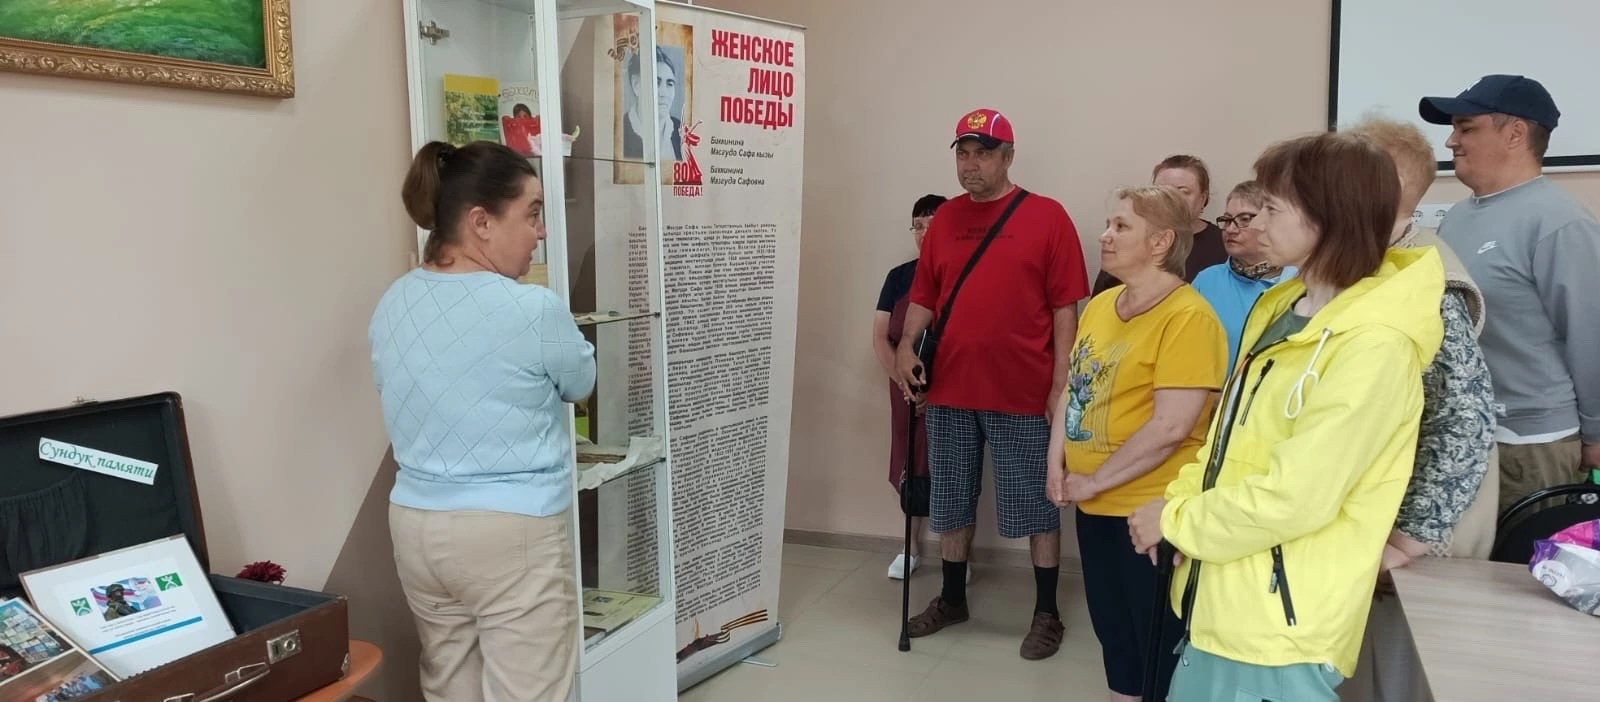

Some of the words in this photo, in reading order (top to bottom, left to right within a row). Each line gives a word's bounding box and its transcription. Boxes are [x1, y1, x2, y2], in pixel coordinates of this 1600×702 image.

[711, 29, 794, 68] ЖЕНСКОЕ
[747, 68, 794, 101] ЛИЦО
[720, 96, 794, 130] ПОБЕДЫ
[673, 162, 688, 182] 80
[673, 185, 703, 197] ПОБЕДА!
[40, 441, 96, 468] Сундук
[96, 457, 154, 479] памяти
